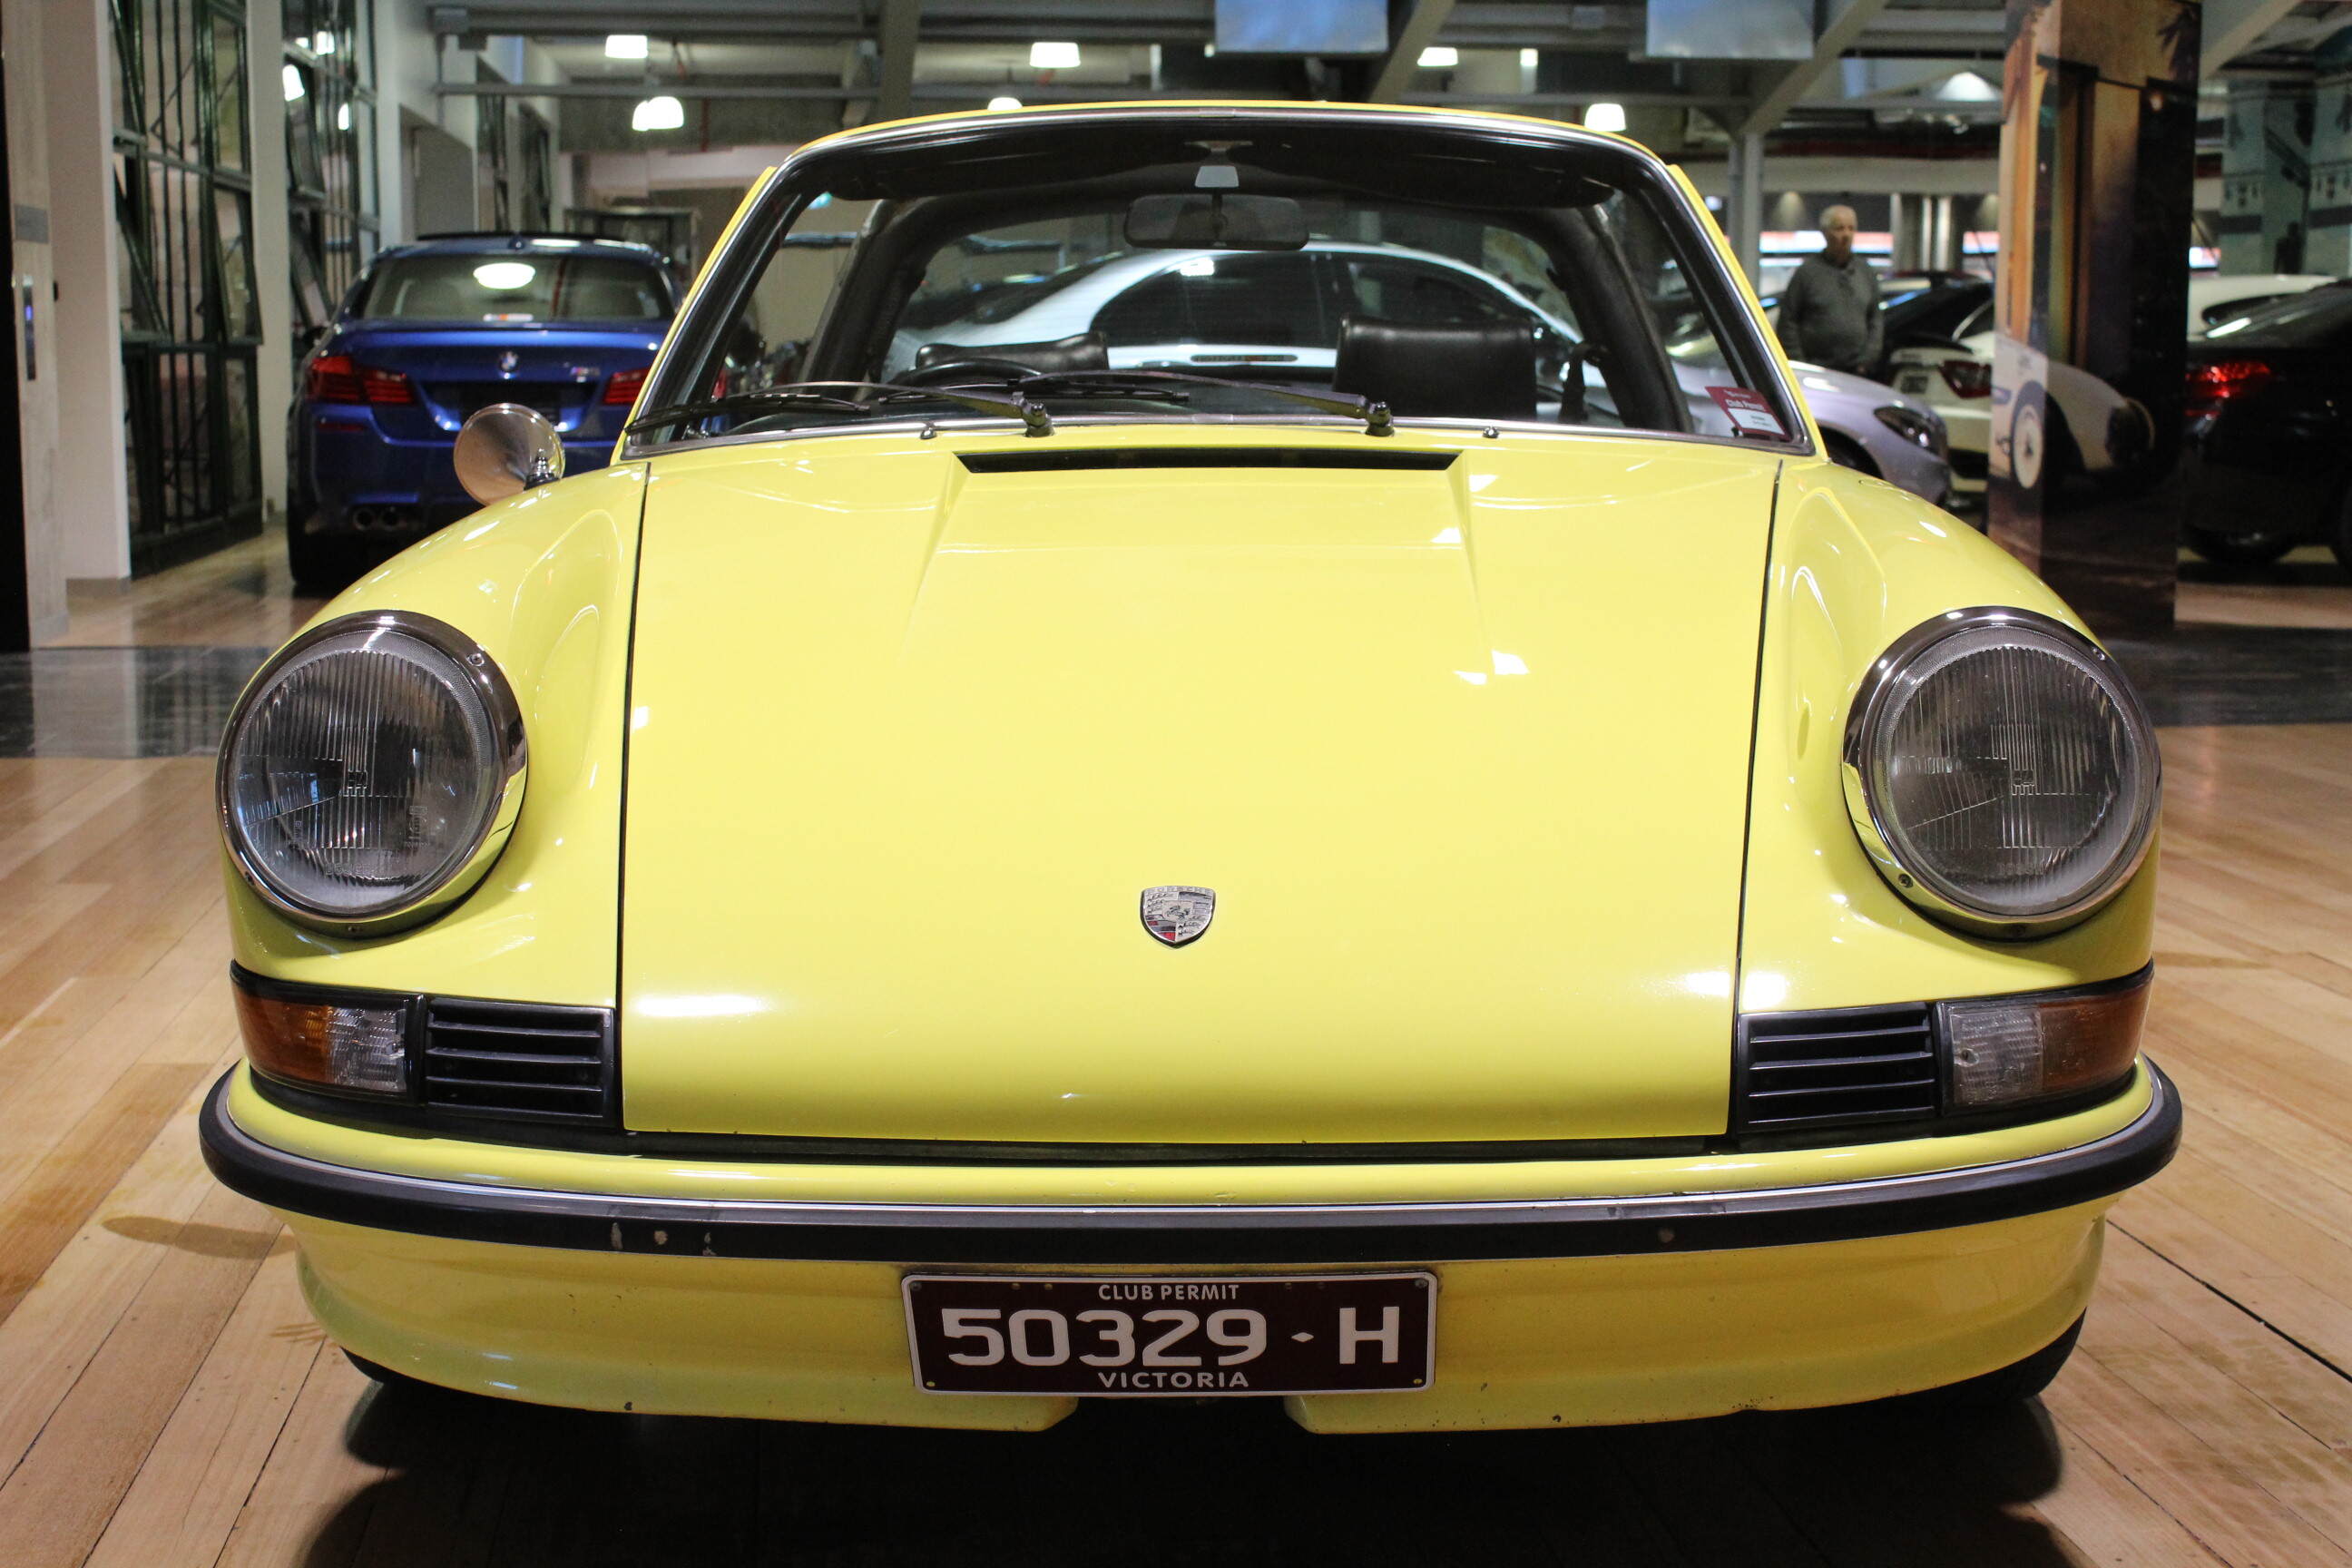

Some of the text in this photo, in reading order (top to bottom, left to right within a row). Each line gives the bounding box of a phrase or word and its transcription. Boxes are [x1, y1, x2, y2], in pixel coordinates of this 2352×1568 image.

[1098, 1284, 1240, 1300] CLUB PERMIT
[941, 1305, 1400, 1367] 50329 H
[1097, 1371, 1250, 1388] VICTORIA
